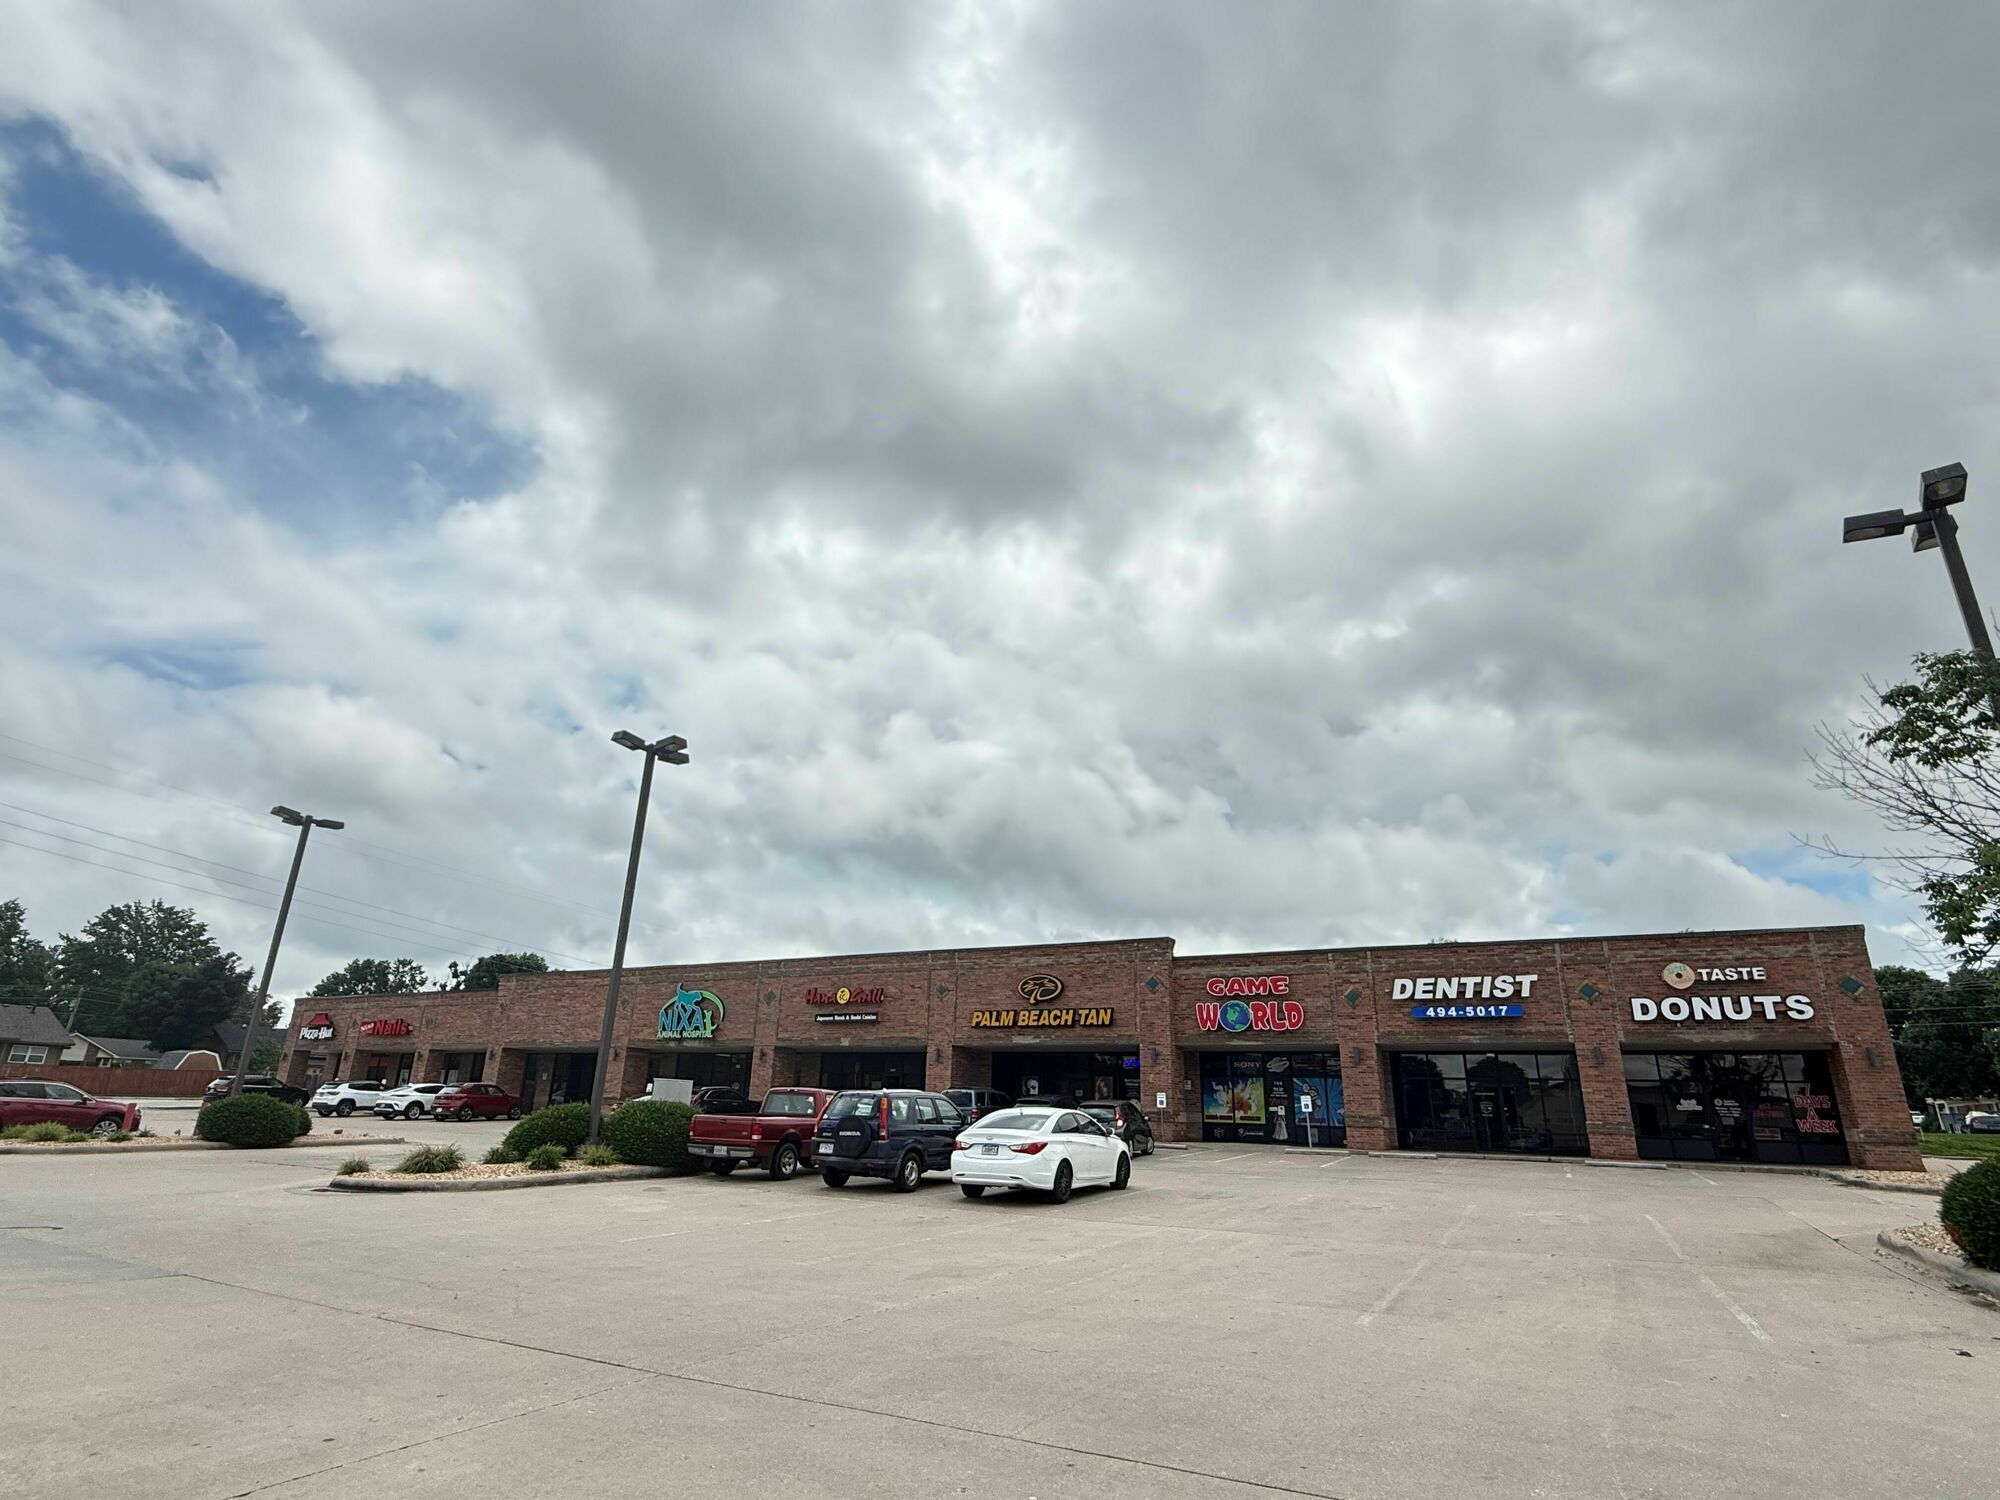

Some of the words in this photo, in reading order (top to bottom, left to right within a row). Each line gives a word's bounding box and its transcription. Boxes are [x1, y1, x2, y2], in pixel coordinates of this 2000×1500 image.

[1698, 967, 1767, 982] TASTE
[1207, 976, 1289, 996] GAME
[1392, 974, 1538, 1000] DENTIST
[1196, 1000, 1304, 1032] WORLD
[1426, 1006, 1508, 1017] 494-5017
[1630, 995, 1815, 1021] DONUTS
[658, 1003, 704, 1031] NIXA
[971, 1010, 1014, 1027] PALM
[1017, 1009, 1074, 1026] BEACH
[1078, 1008, 1112, 1025] TAN
[299, 1027, 319, 1039] Pizza
[319, 1026, 334, 1039] Hut
[374, 1018, 409, 1036] Nails
[656, 1030, 681, 1038] ANIMAL
[682, 1030, 713, 1038] HOSPITAL
[1793, 1095, 1831, 1108] DAYS
[1806, 1105, 1819, 1119] A
[1796, 1119, 1839, 1134] WEEK
